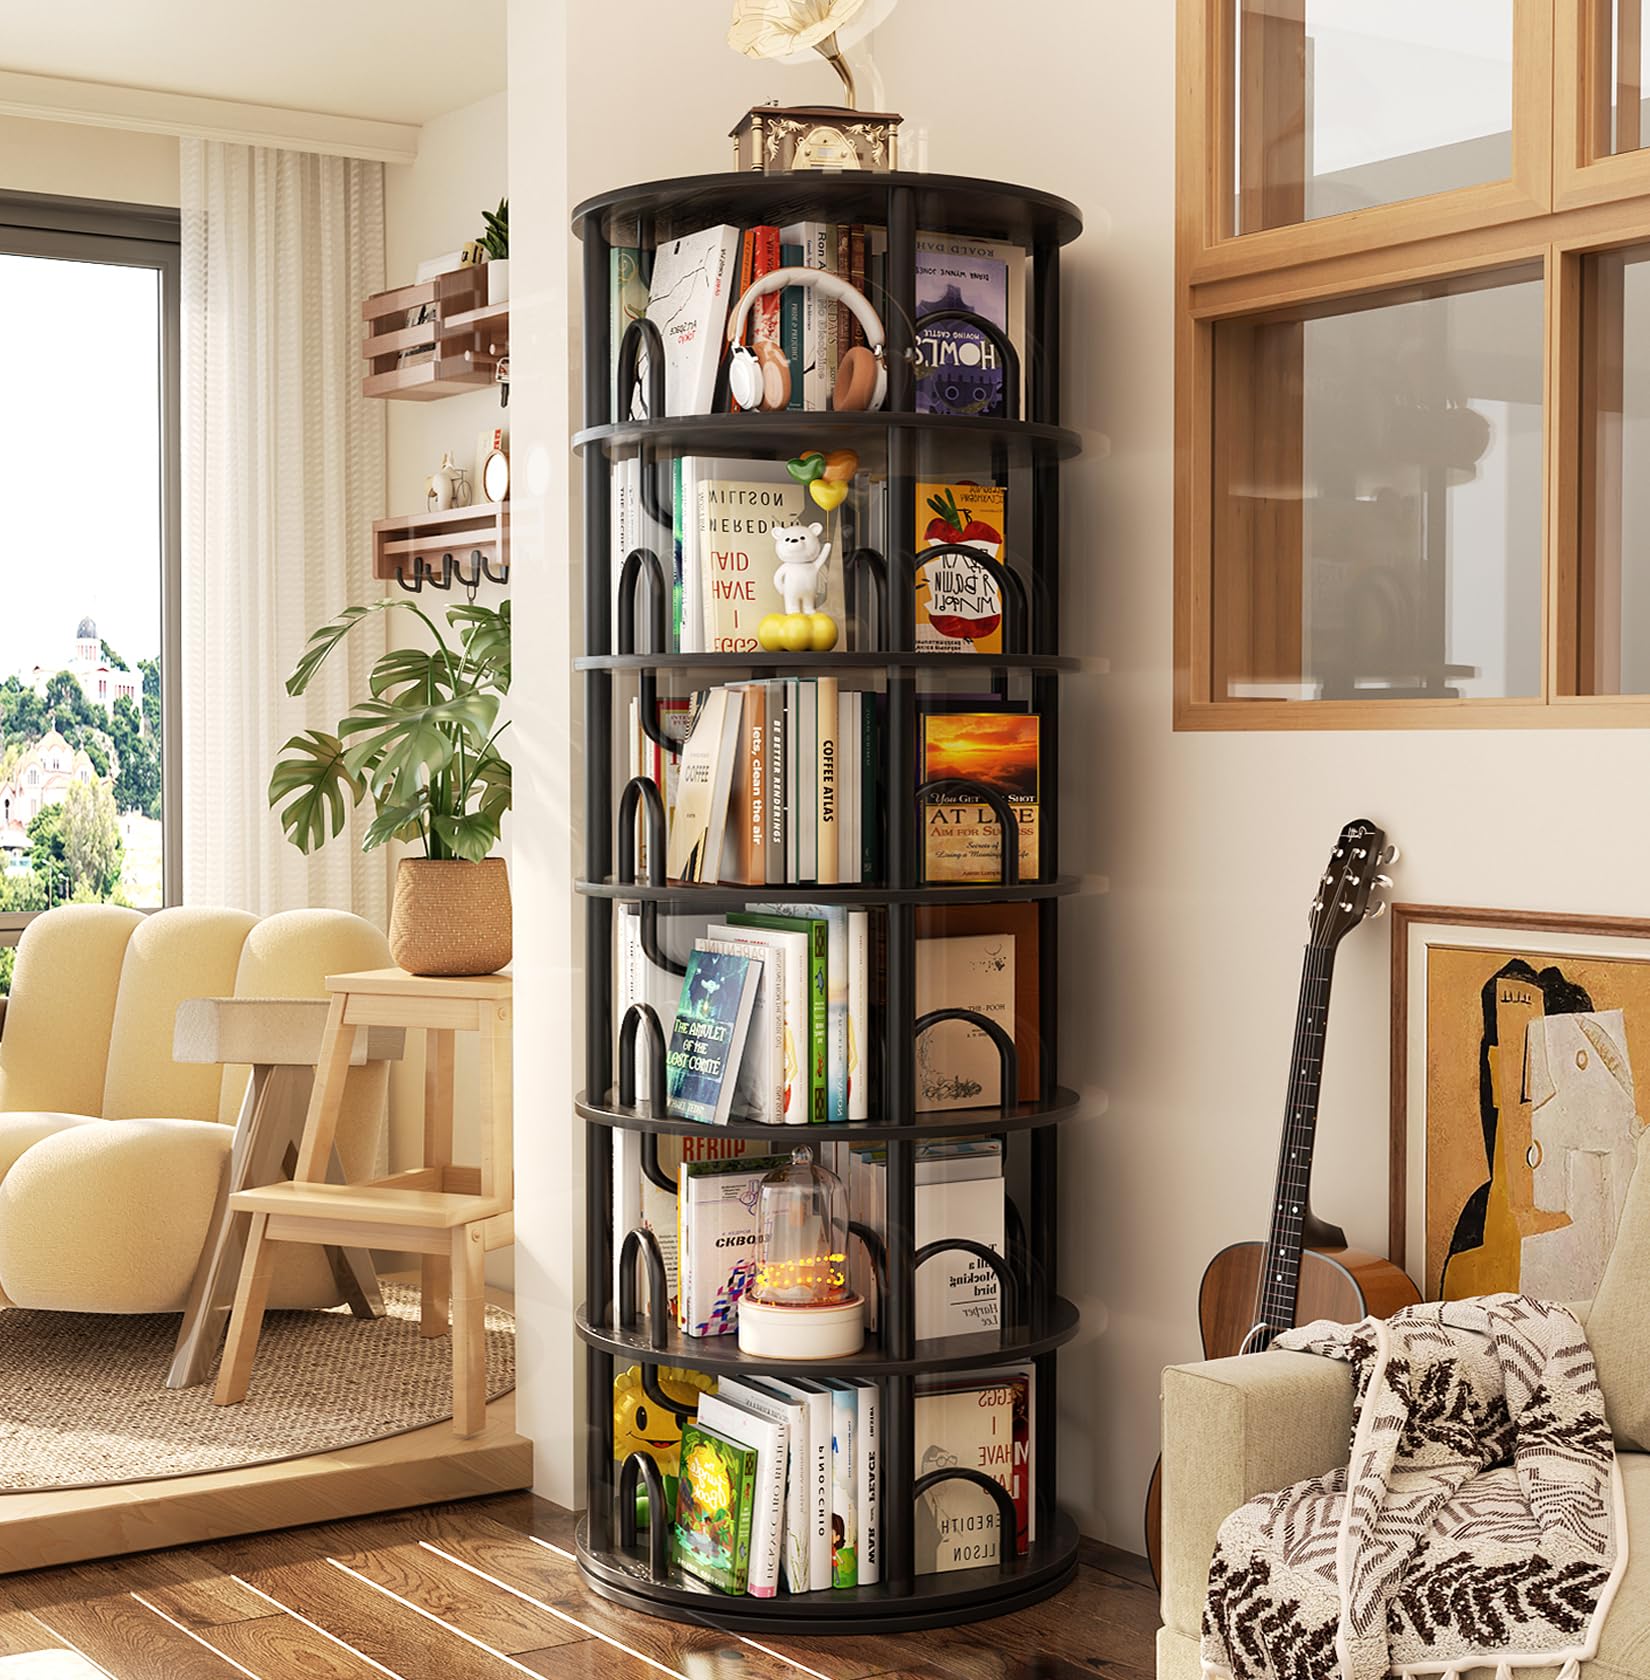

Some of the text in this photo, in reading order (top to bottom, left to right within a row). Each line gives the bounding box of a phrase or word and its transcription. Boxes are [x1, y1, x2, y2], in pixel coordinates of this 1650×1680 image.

[818, 231, 828, 257] Ron
[916, 241, 994, 258] ROALD DAH
[827, 312, 838, 345] DAYS
[923, 329, 980, 340] MOVING CASTLE
[751, 726, 762, 845] lets, clean the air
[773, 720, 781, 843] BE BETTER RENDERINGS
[823, 740, 834, 823] COFFEE ATLAS
[930, 792, 957, 806] You
[930, 808, 966, 824] AT
[931, 826, 1034, 837] AIM FOR SUSS
[674, 1019, 727, 1042] THE AMULET
[682, 1039, 695, 1052] OF
[666, 1050, 690, 1068] LOST
